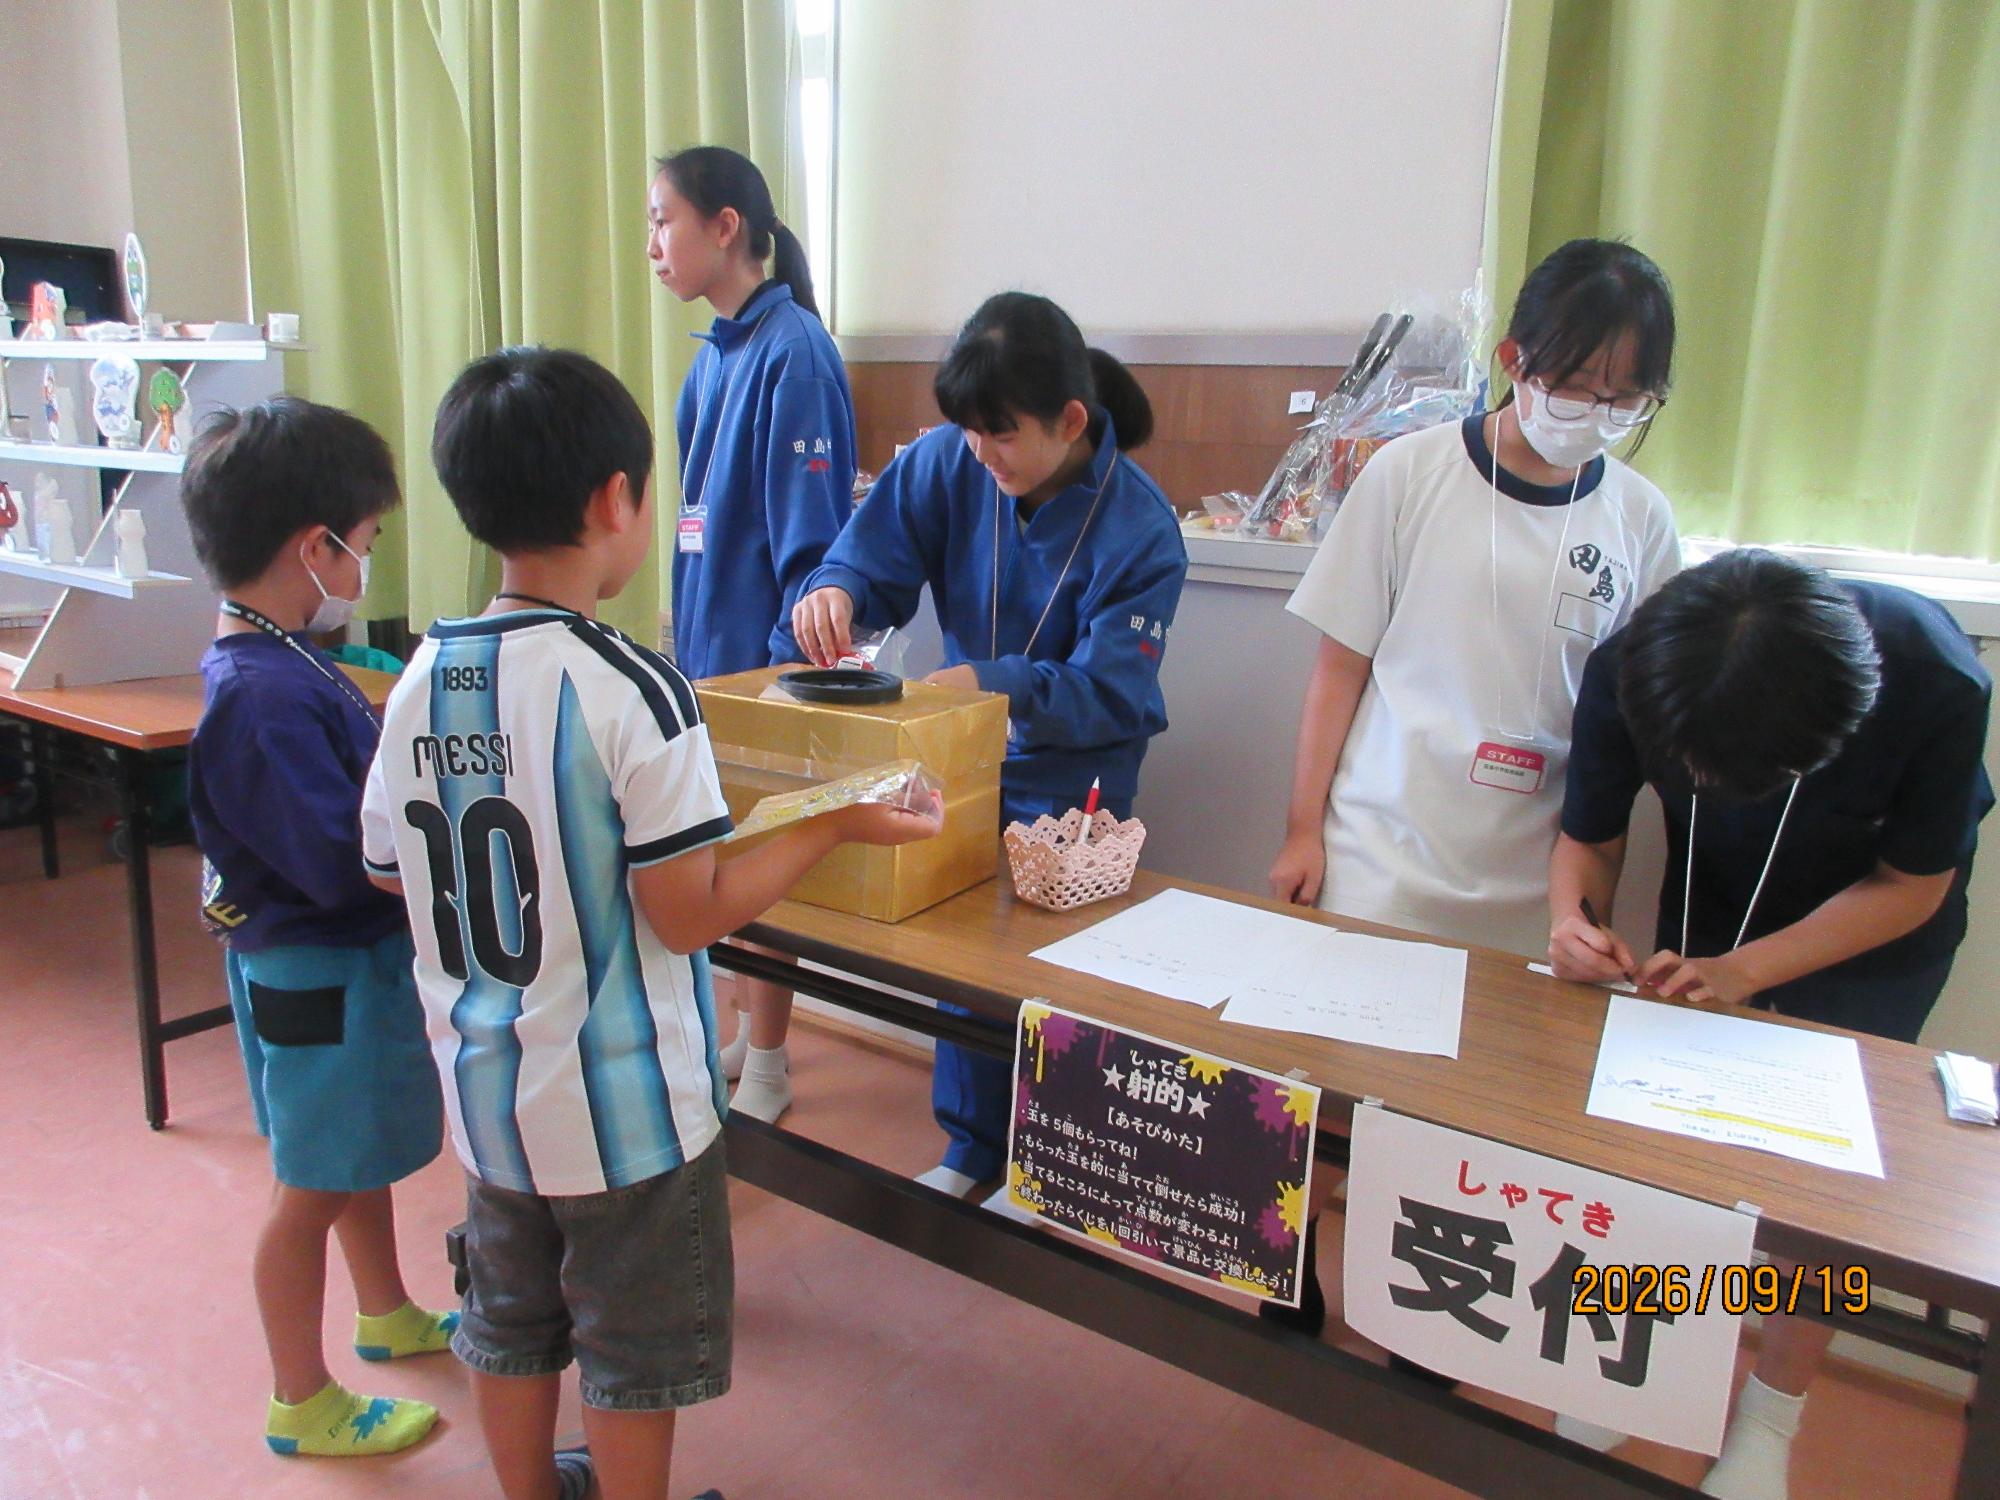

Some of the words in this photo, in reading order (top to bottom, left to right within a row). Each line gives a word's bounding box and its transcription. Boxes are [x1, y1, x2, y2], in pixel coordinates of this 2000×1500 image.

[441, 666, 489, 692] 1893
[412, 732, 514, 778] MESSI
[1486, 750, 1536, 766] STAFF
[404, 796, 544, 989] 10
[1130, 1049, 1187, 1080] しゃてき
[1126, 1068, 1185, 1113] 射的
[1456, 1159, 1617, 1239] しゃてき
[1387, 1195, 1676, 1389] 受付
